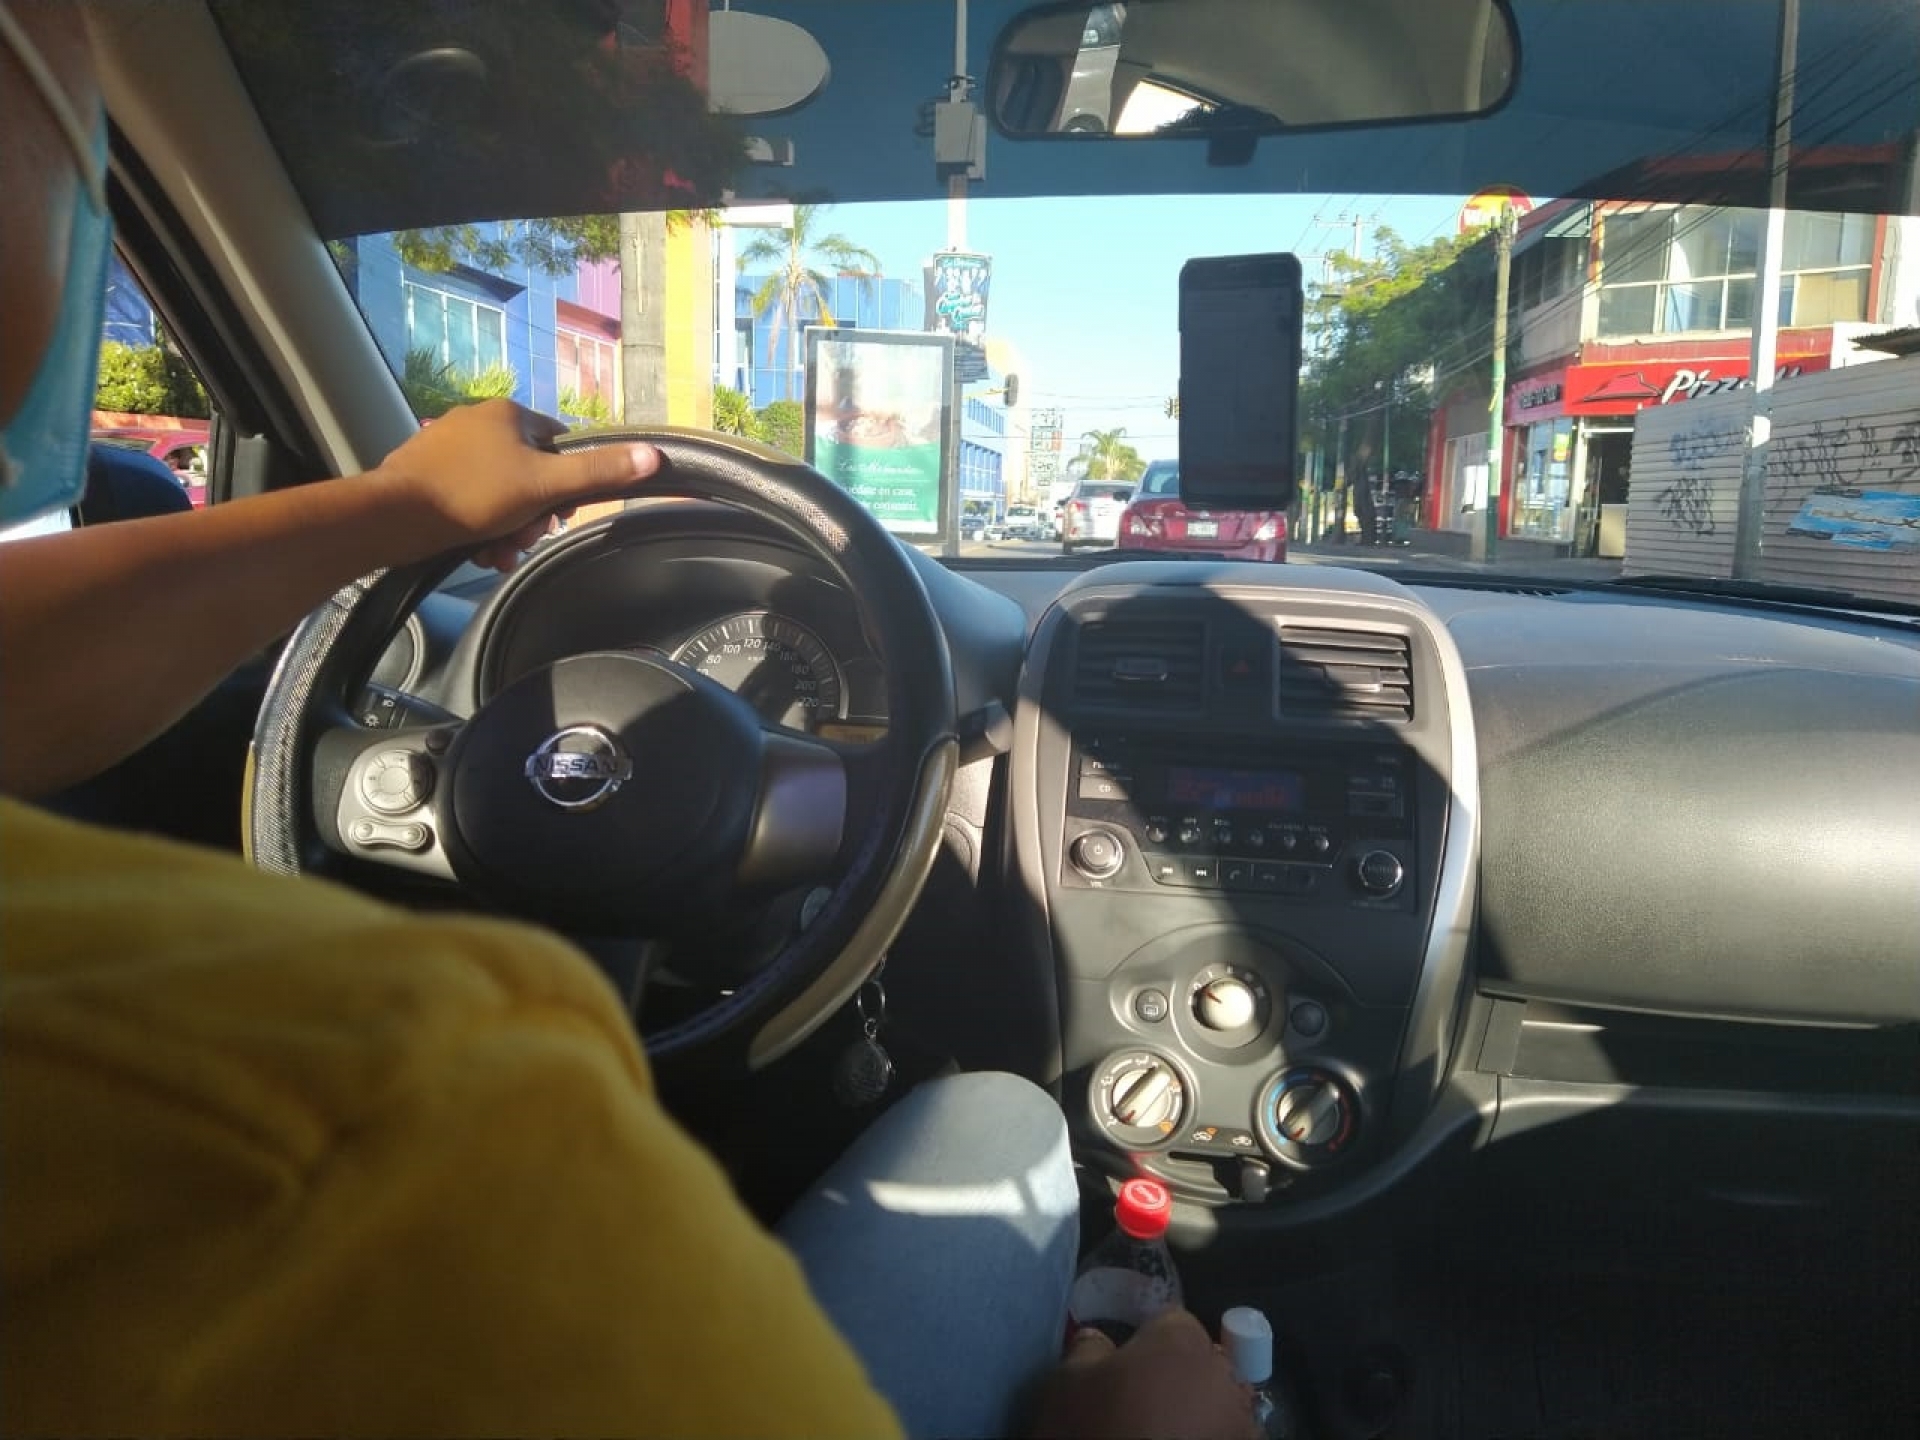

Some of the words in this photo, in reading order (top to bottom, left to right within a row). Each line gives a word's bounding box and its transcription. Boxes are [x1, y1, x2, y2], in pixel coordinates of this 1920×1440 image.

[722, 643, 742, 654] 100
[743, 638, 762, 649] 120
[535, 757, 620, 773] NISSAN
